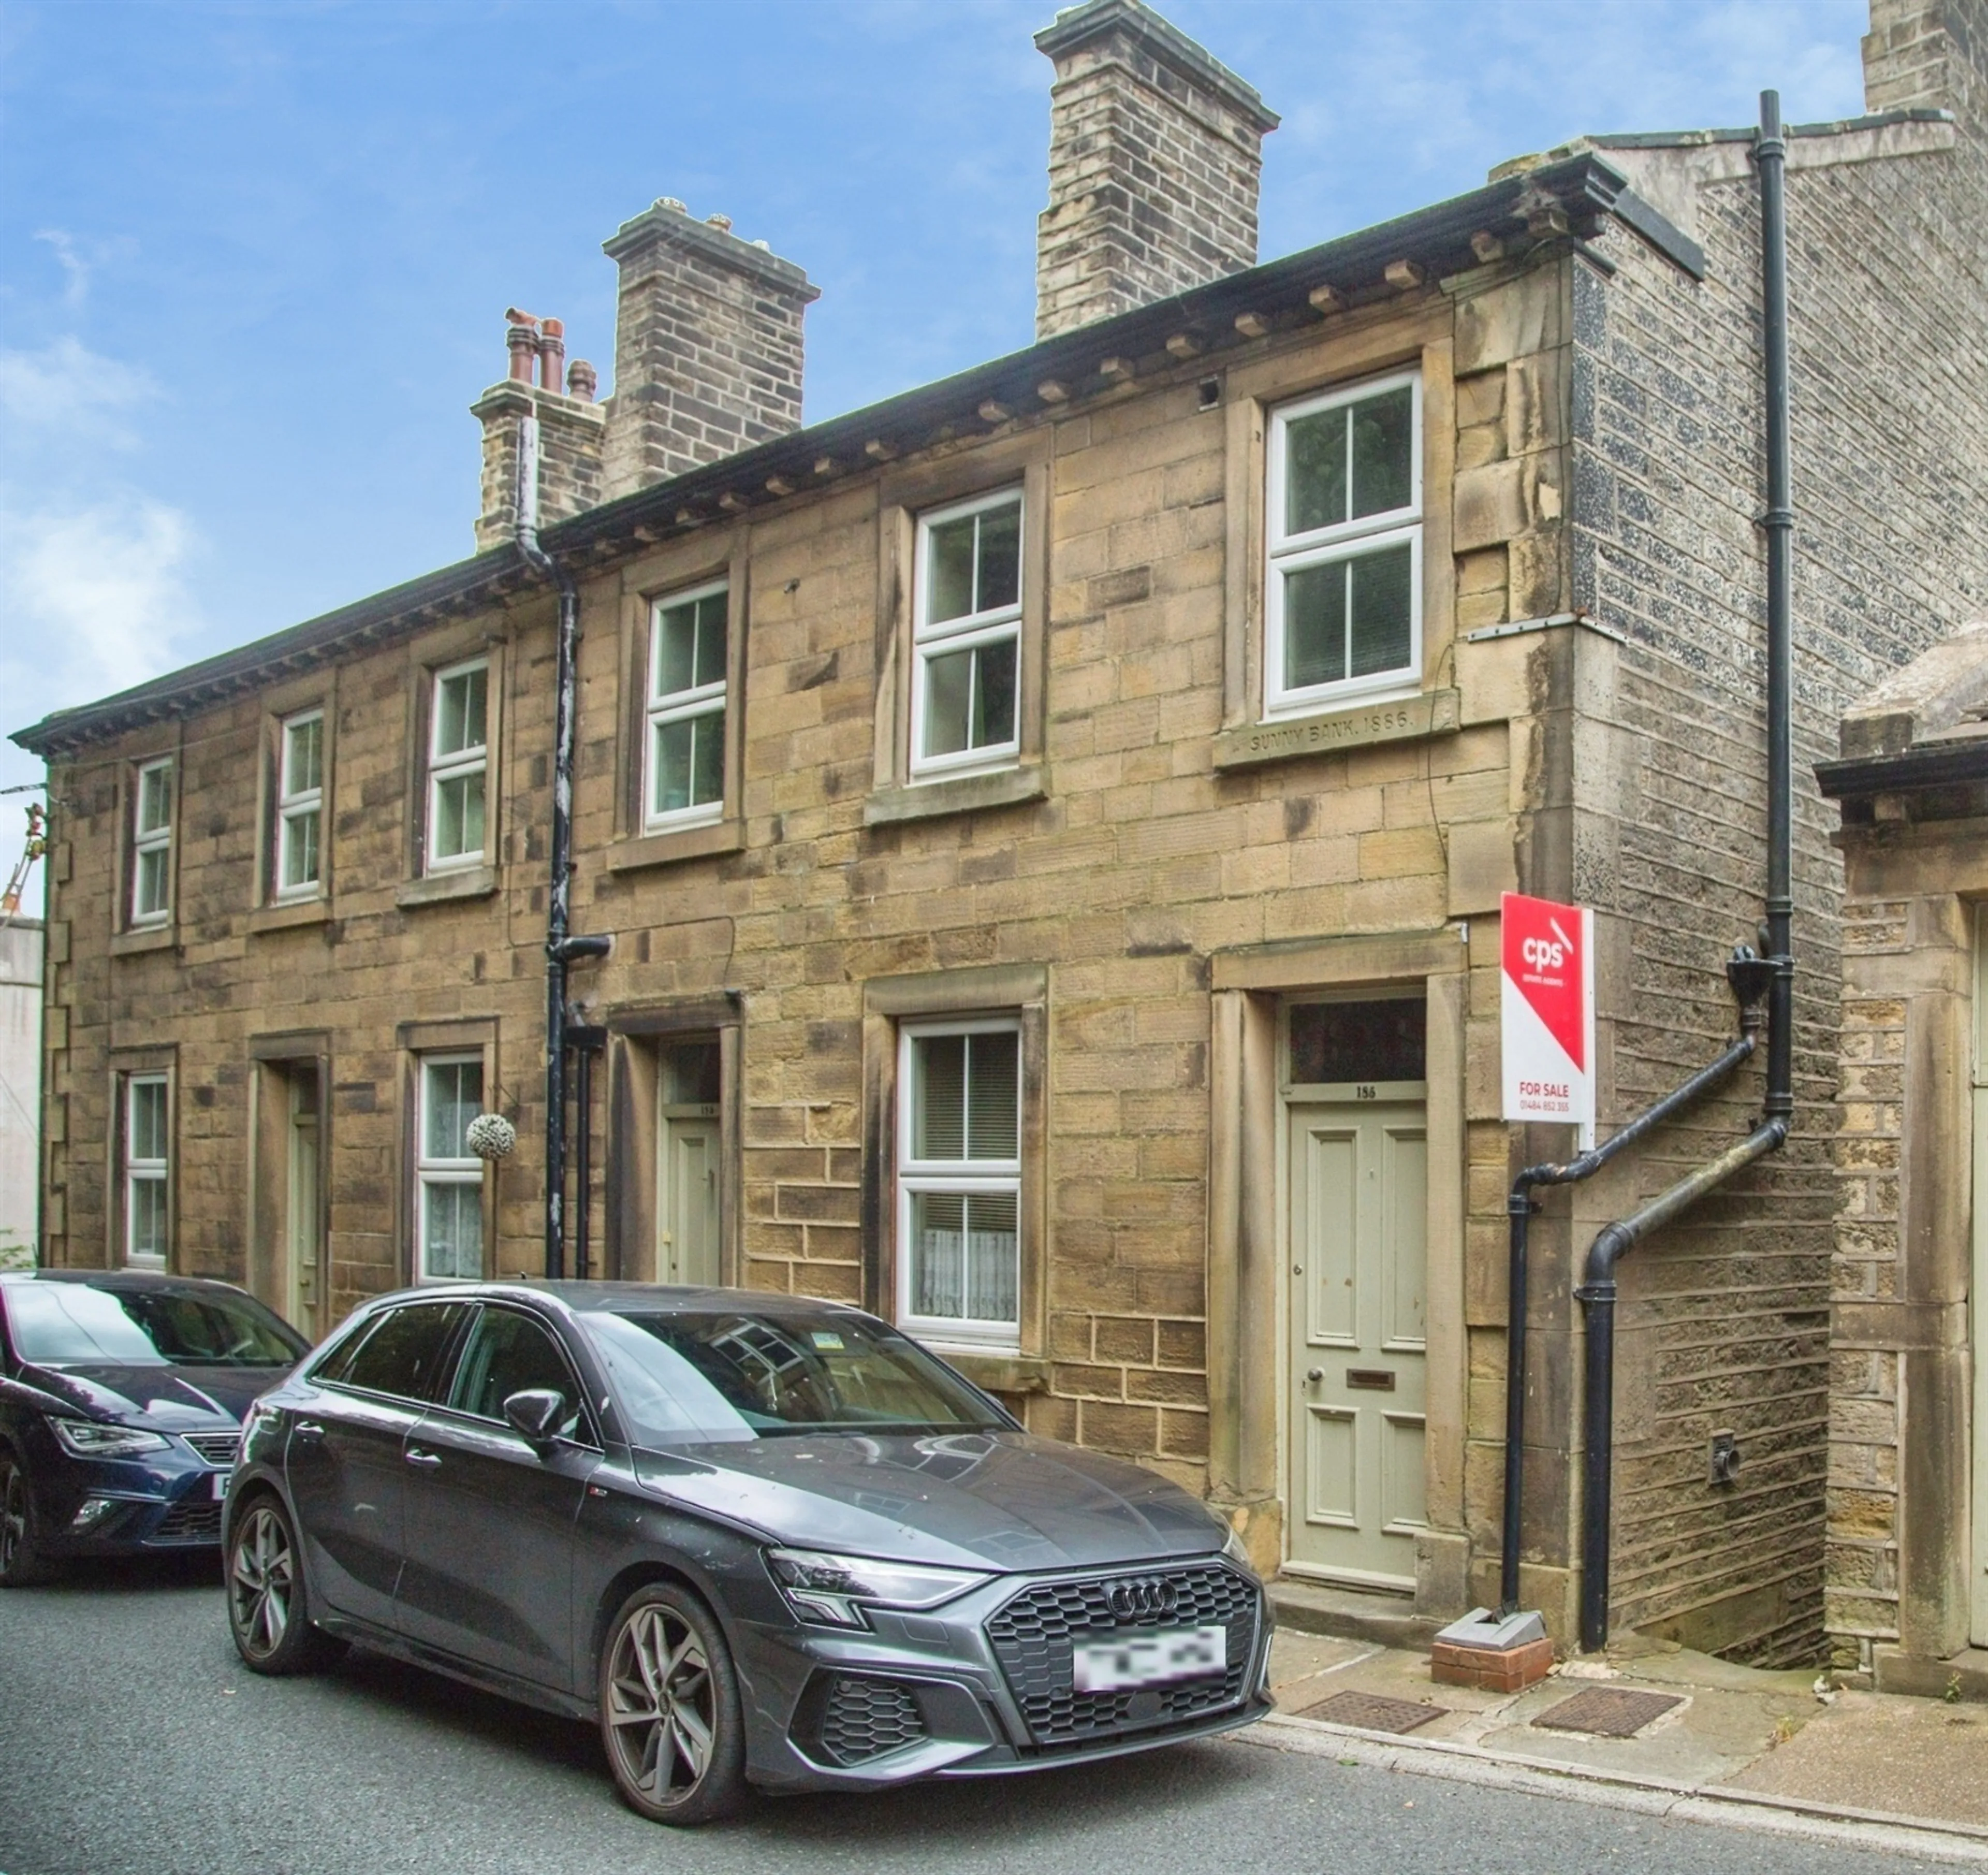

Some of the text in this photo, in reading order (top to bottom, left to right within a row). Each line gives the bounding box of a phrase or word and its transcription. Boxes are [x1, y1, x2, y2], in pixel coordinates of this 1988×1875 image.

[1250, 728, 1304, 751] SUNNY
[1523, 937, 1563, 973] cps
[1519, 1081, 1569, 1098] FOR SALE
